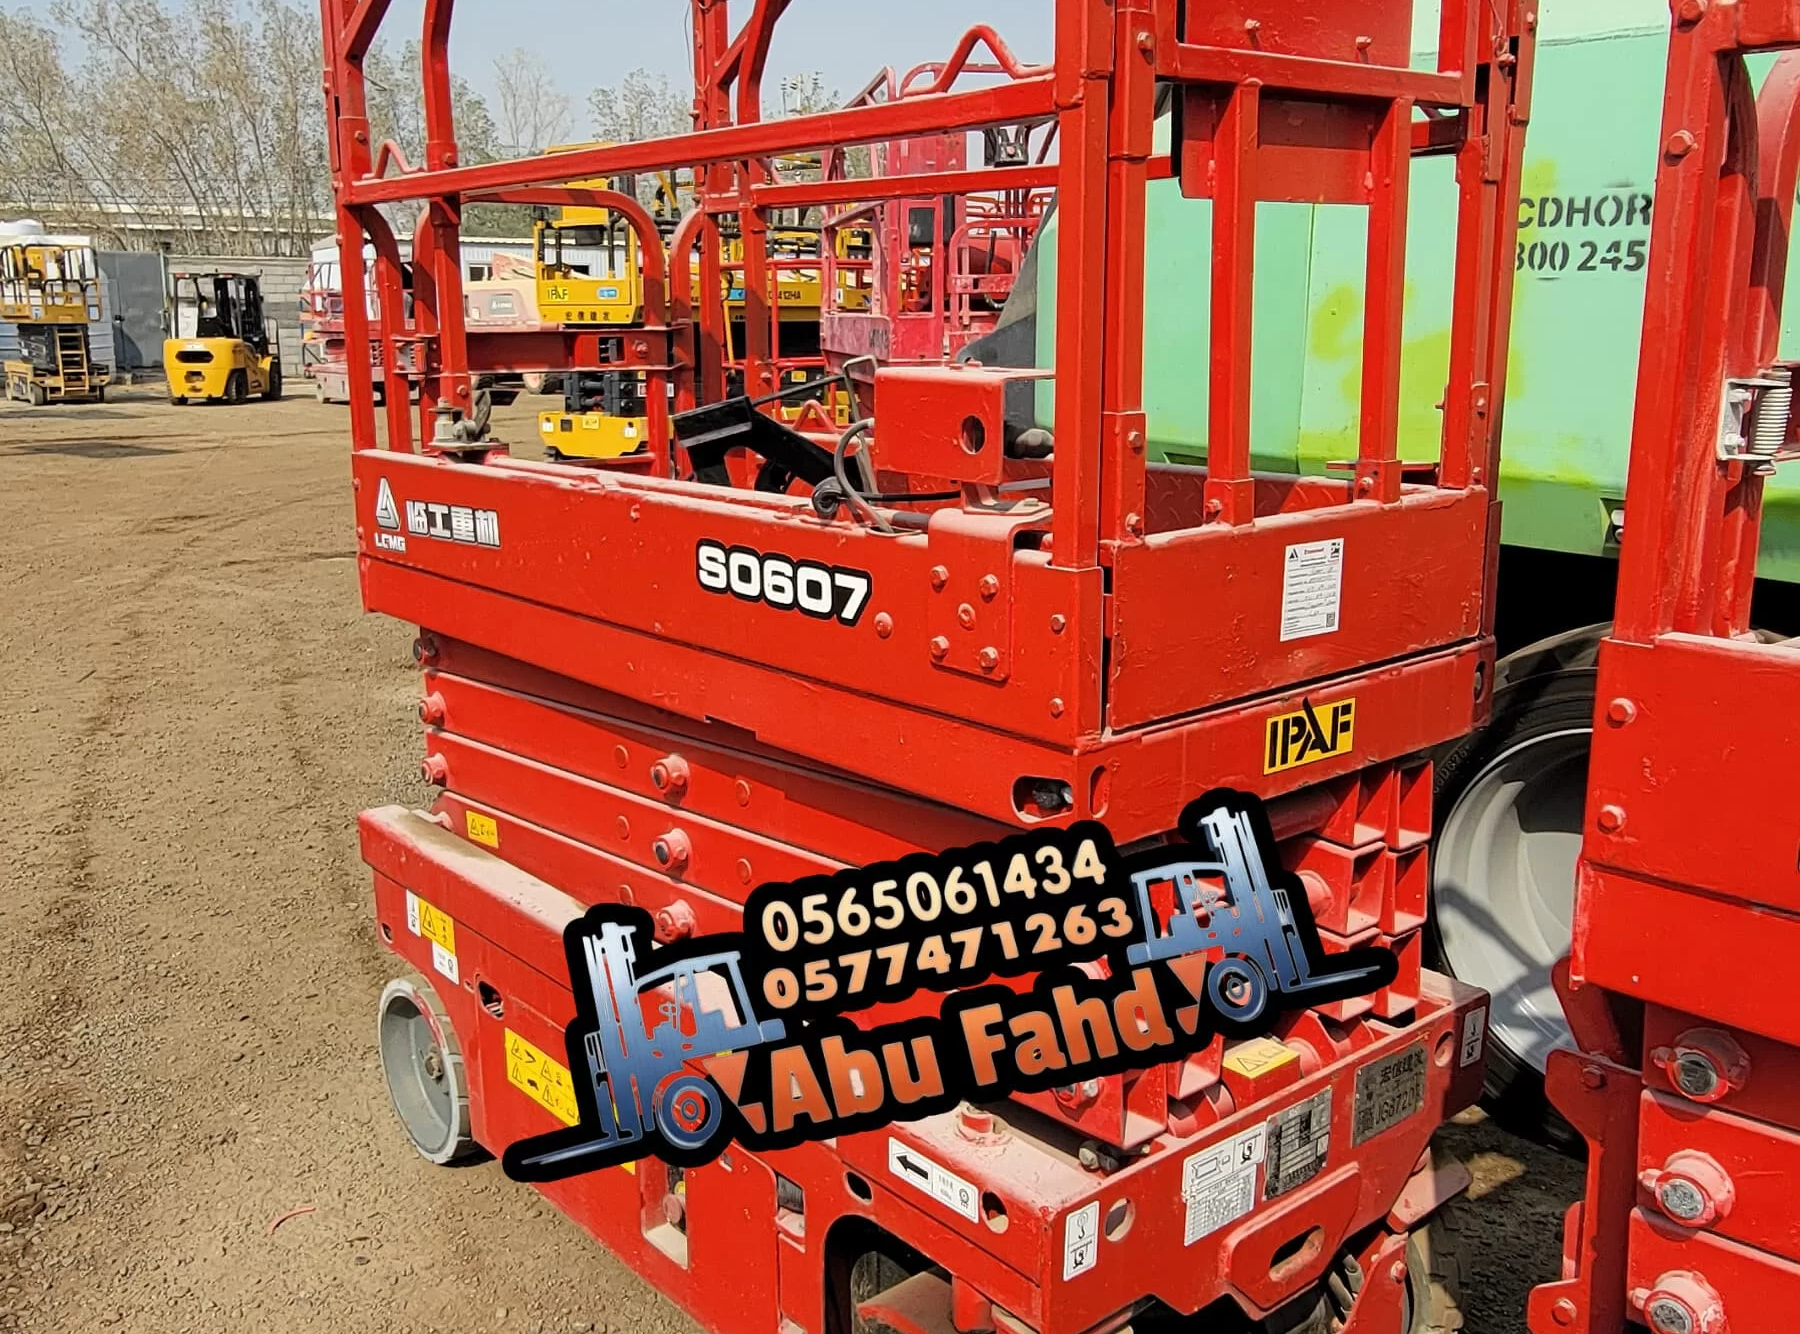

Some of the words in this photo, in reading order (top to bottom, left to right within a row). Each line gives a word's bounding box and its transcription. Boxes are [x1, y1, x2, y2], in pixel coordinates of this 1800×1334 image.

[405, 499, 500, 546] 临工重机
[1268, 696, 1353, 769] IPAF
